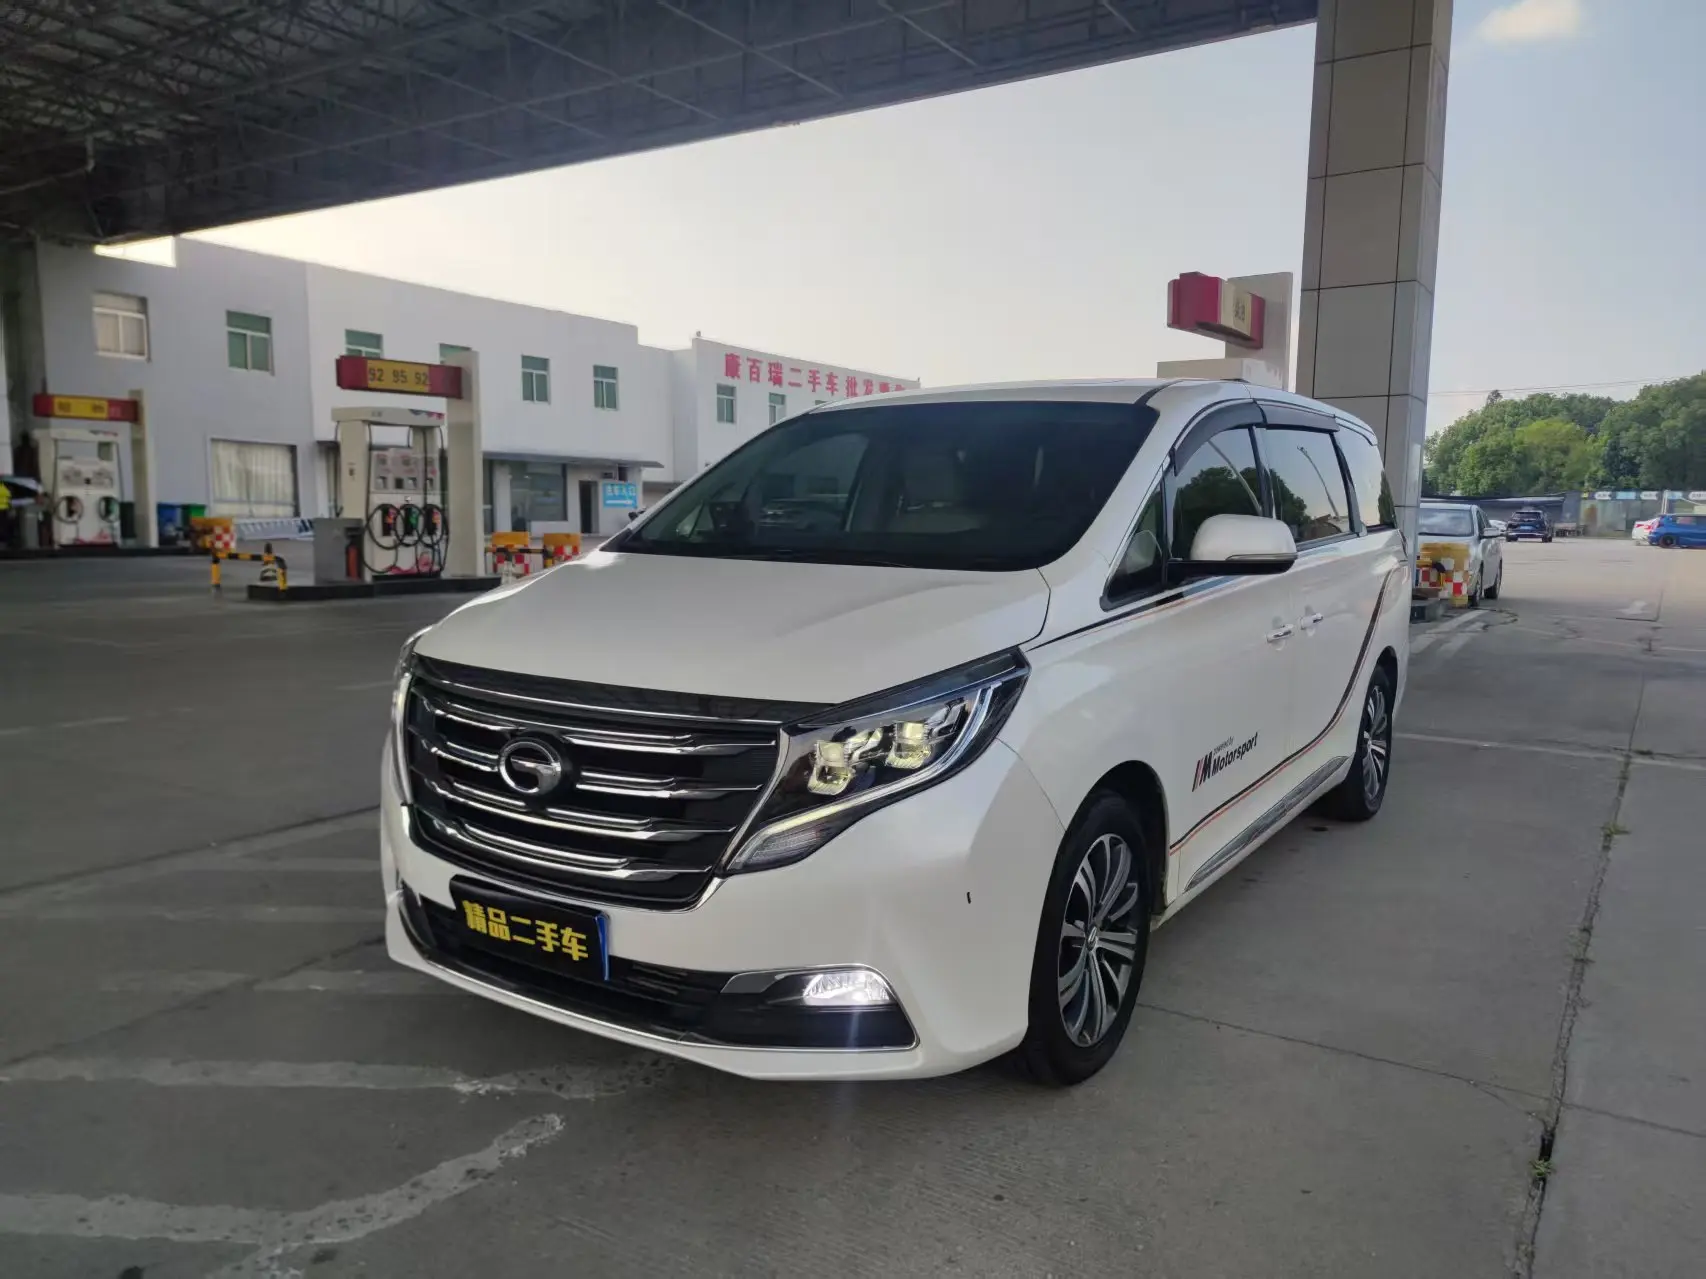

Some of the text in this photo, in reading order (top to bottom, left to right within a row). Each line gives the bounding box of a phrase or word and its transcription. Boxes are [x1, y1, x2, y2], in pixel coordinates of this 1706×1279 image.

[368, 367, 429, 385] 92 95 92
[1211, 732, 1258, 777] Motorsport
[461, 899, 589, 961] 精品二手车
